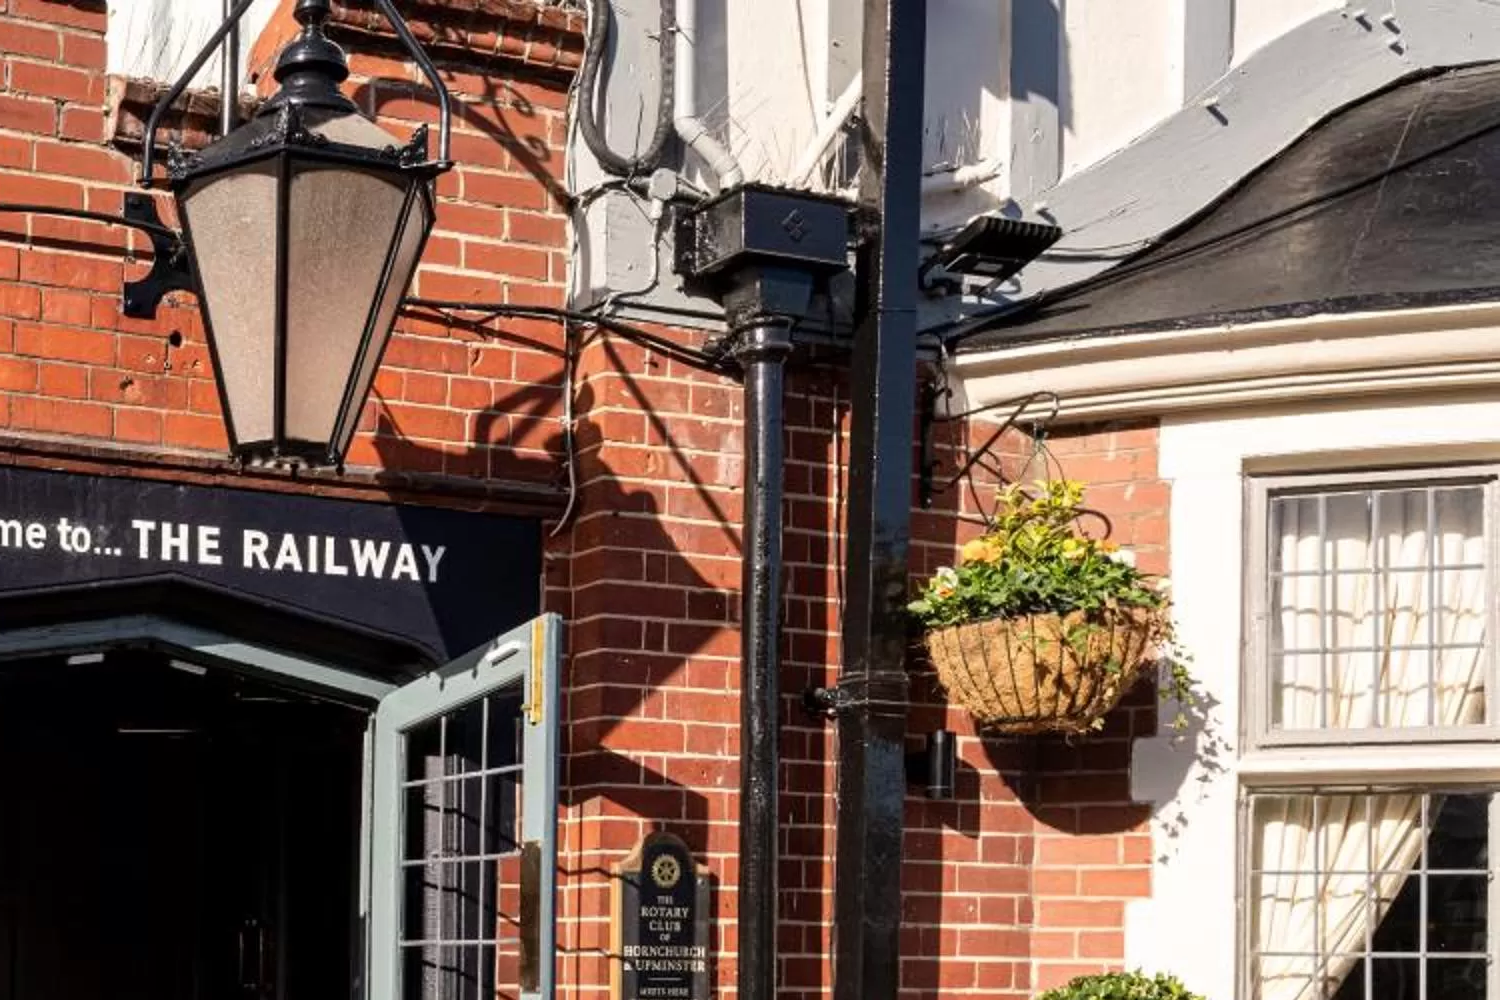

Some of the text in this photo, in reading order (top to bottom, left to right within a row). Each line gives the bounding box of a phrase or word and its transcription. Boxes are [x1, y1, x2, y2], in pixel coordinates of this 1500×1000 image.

[56, 518, 123, 558] to...
[131, 519, 223, 566] THE
[243, 528, 446, 583] RAILWAY
[641, 906, 689, 918] ROTARY
[649, 920, 681, 932] CLUB
[623, 945, 706, 958] HORNCHURCH
[635, 959, 706, 972] UPMINSTER
